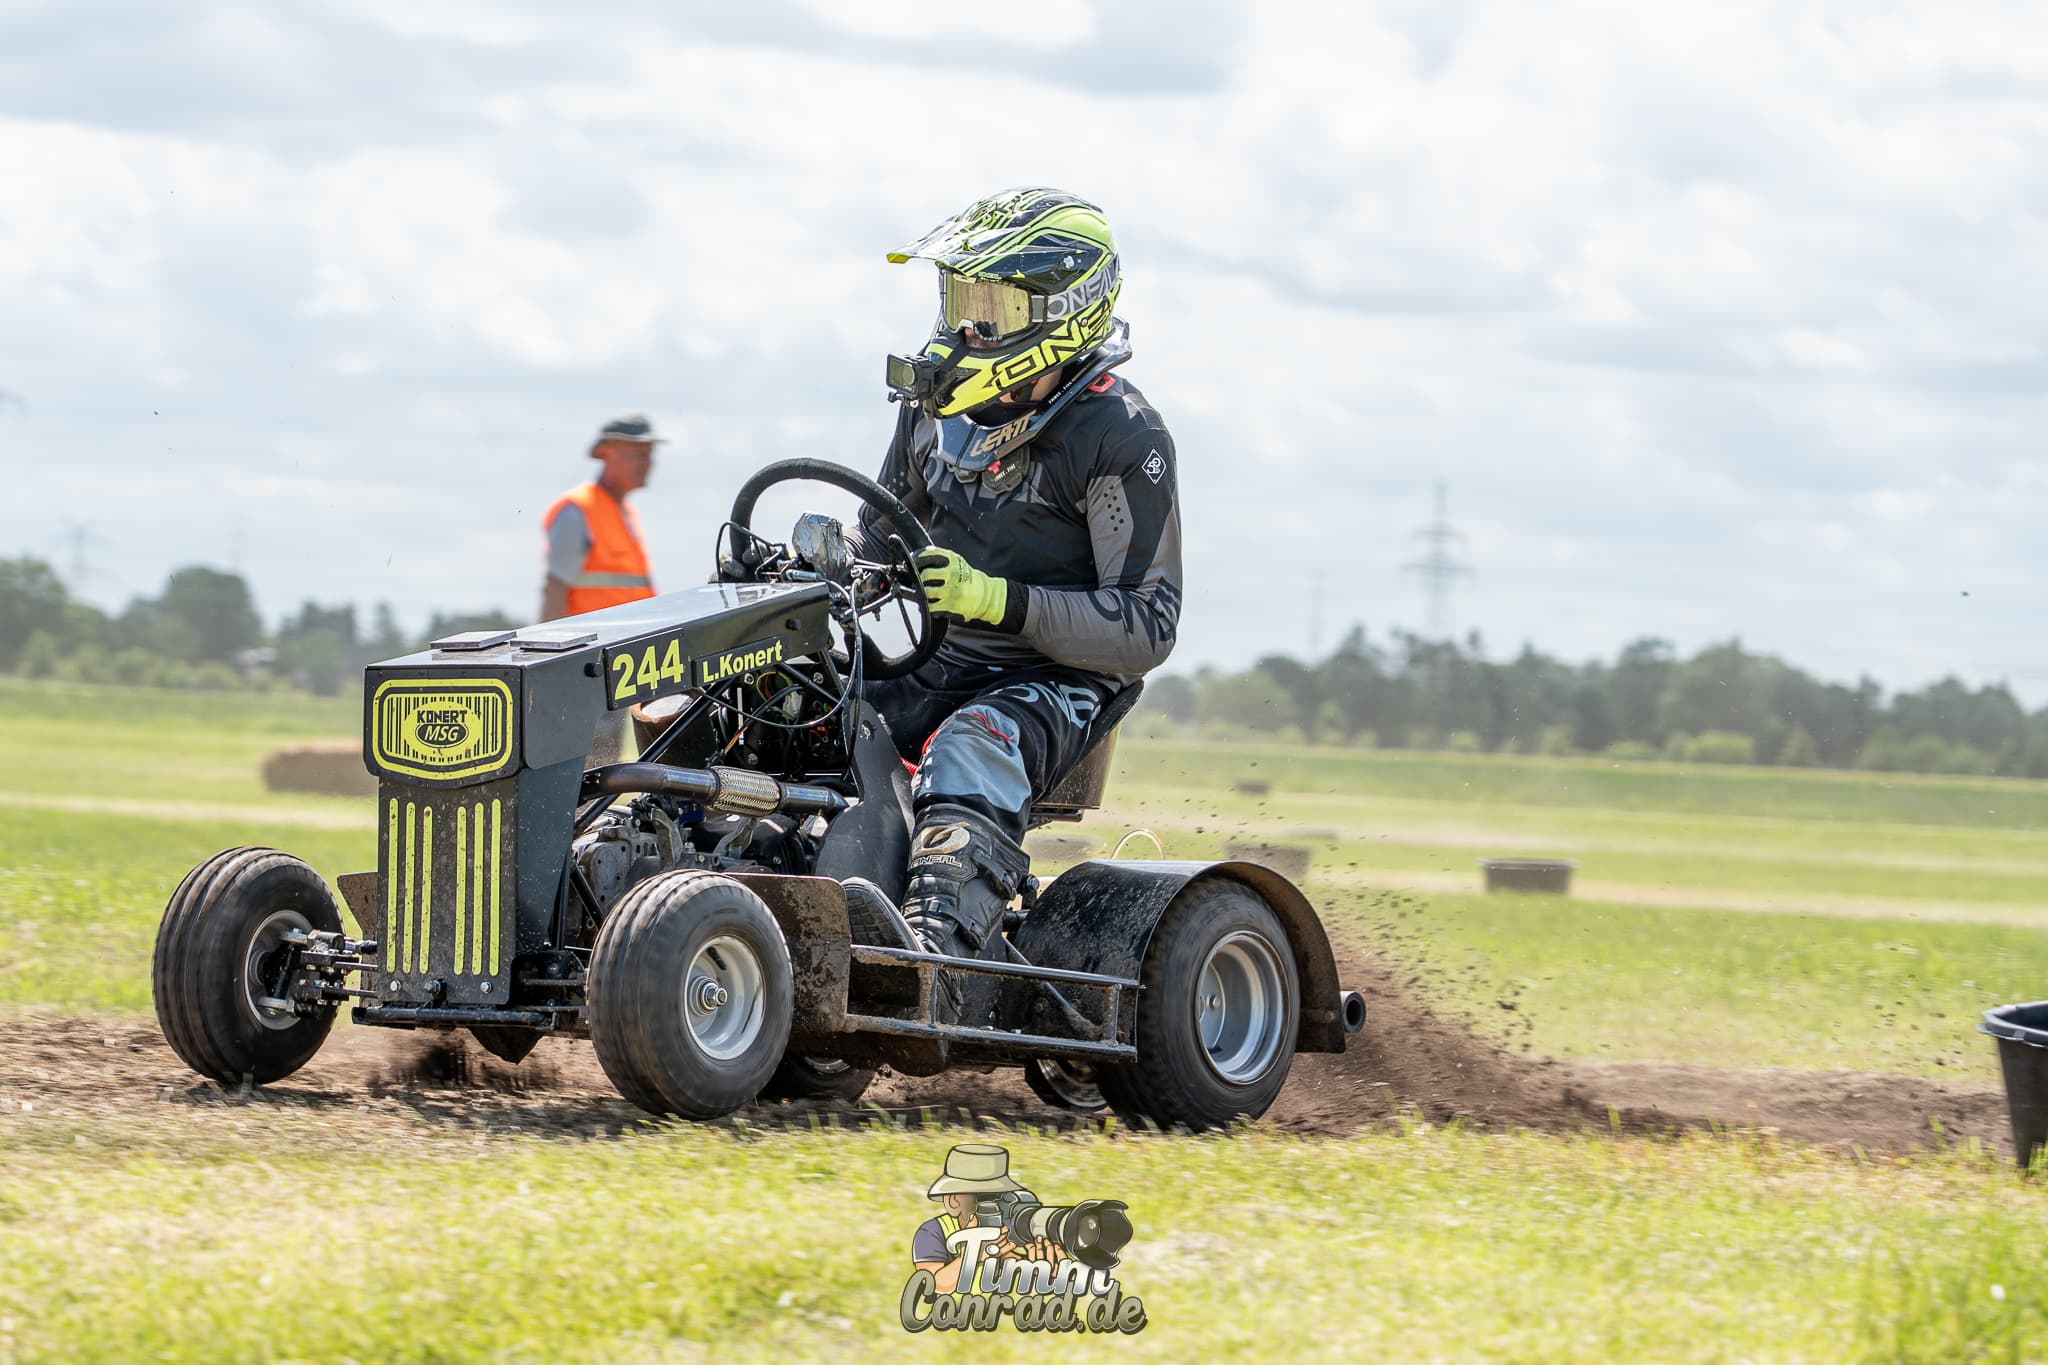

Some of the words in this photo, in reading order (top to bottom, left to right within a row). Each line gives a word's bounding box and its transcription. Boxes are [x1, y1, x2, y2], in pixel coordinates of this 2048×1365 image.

[612, 638, 684, 701] 244
[702, 639, 783, 684] L.Konert
[416, 709, 468, 724] KONERT
[424, 725, 460, 742] MSG
